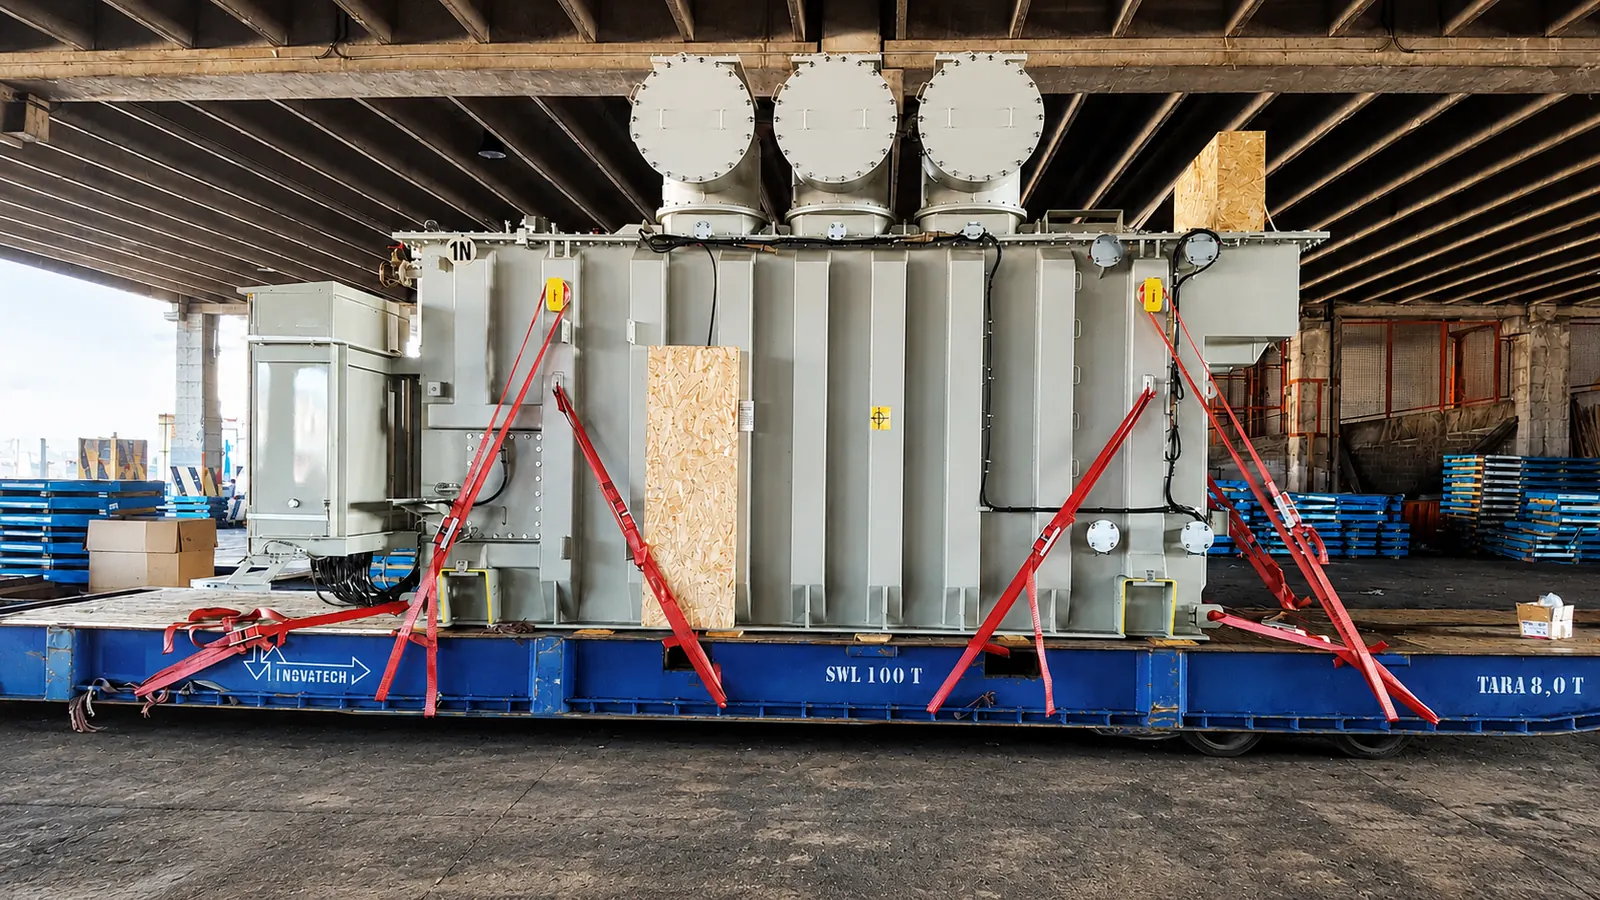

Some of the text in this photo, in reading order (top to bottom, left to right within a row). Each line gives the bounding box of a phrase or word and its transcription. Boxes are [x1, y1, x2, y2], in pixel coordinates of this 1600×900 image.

[450, 241, 471, 261] 1N
[825, 665, 923, 684] SWL 100 T
[1477, 676, 1584, 698] TARA 8,0 T
